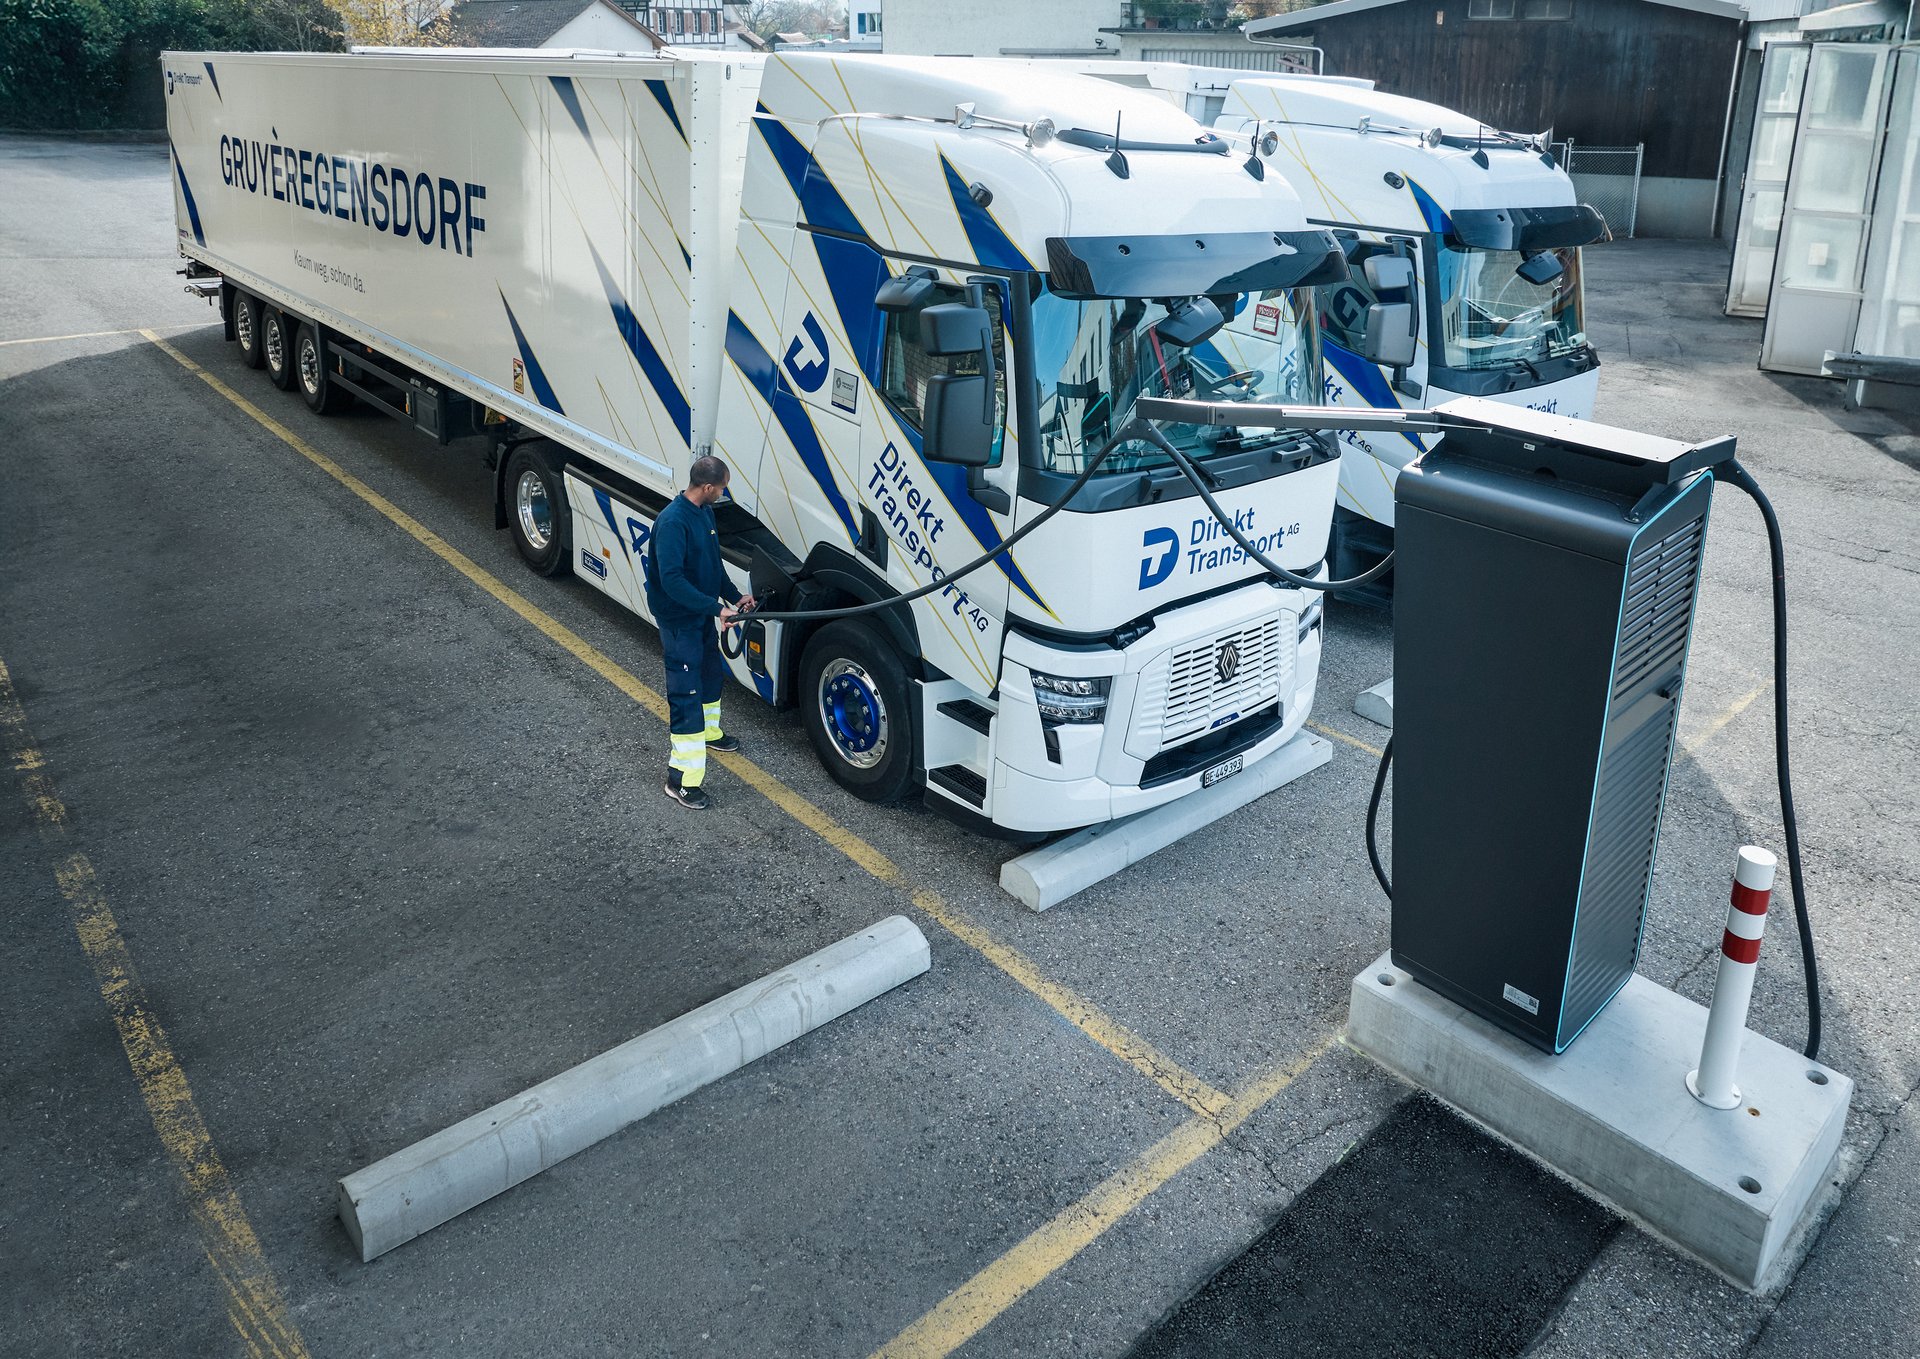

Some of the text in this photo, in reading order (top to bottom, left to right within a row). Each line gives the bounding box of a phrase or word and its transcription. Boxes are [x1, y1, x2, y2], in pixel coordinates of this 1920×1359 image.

[220, 125, 486, 258] GRUYÈREGENSDORF
[293, 249, 366, 294] Kaum weg, schon da.
[1358, 440, 1373, 453] AG
[879, 441, 944, 544] Direkt
[1286, 522, 1300, 537] AG
[968, 607, 989, 632] AG
